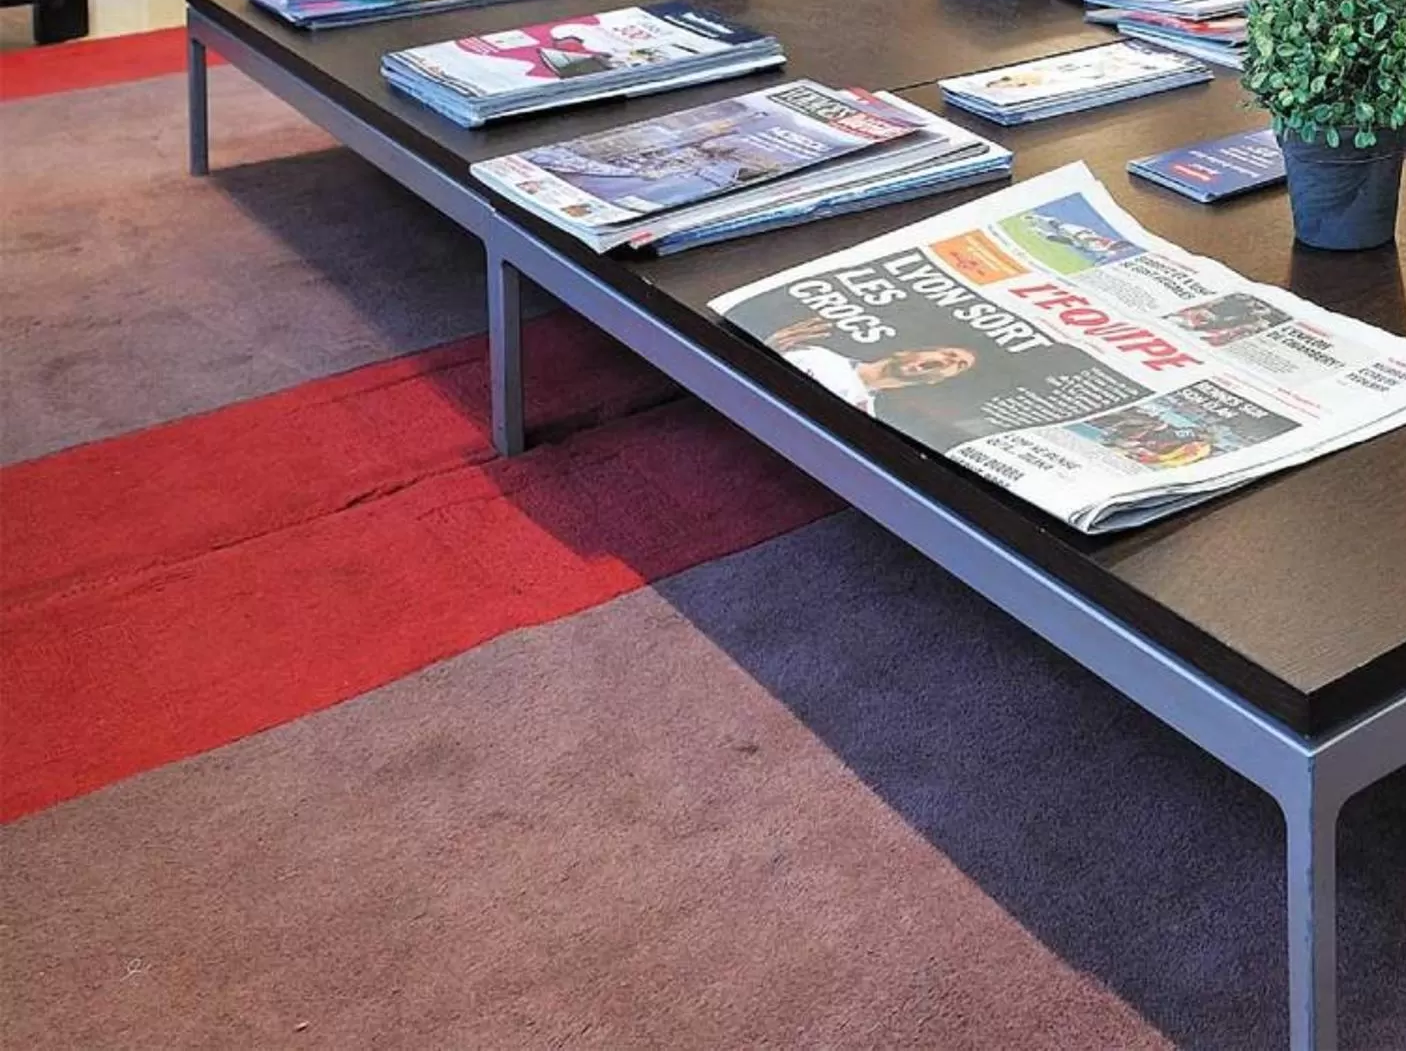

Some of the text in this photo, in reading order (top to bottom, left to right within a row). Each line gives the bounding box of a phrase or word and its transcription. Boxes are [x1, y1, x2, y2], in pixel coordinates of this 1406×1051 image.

[788, 279, 896, 343] CROCS
[834, 267, 907, 306] LES
[883, 252, 973, 307] LYON
[953, 303, 1054, 353] SORT
